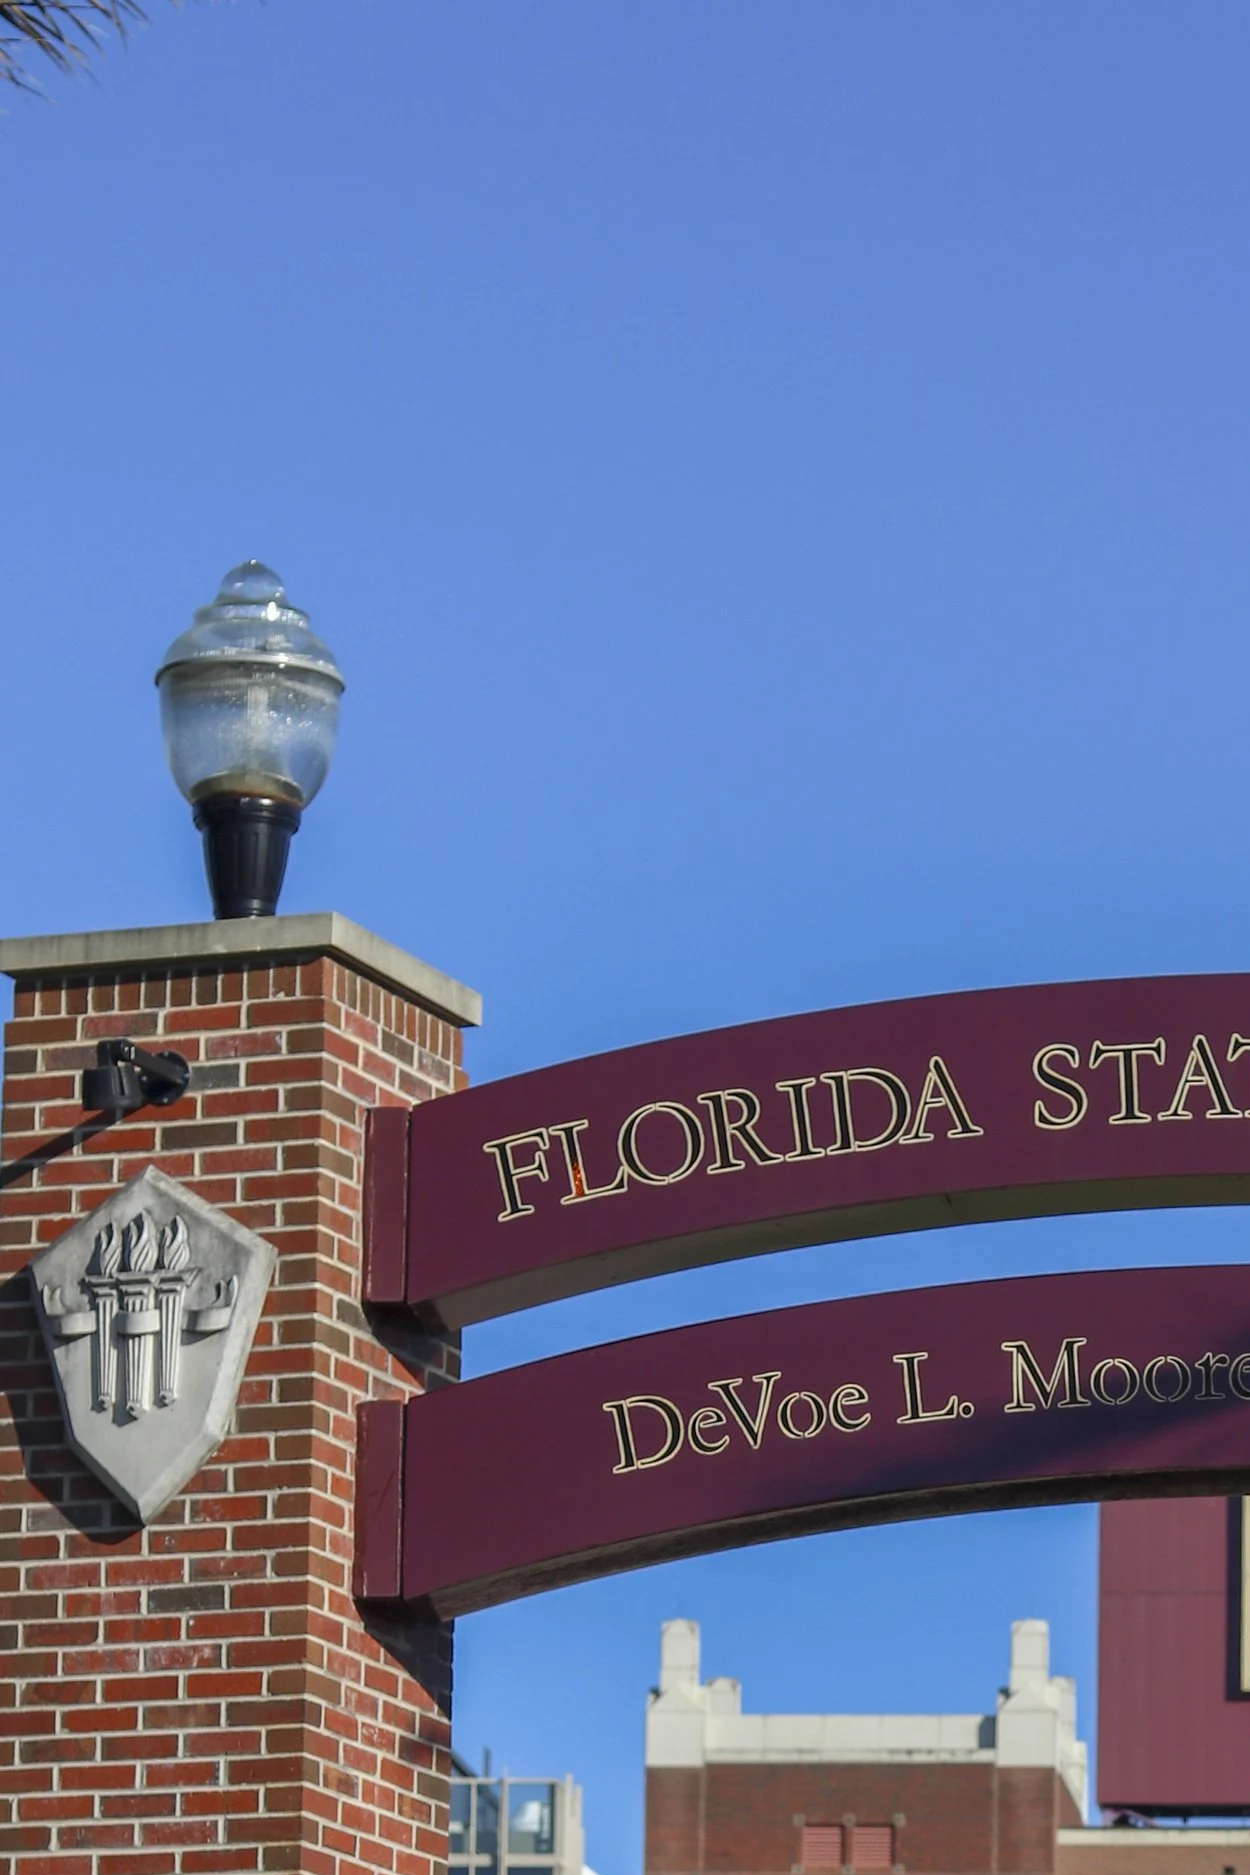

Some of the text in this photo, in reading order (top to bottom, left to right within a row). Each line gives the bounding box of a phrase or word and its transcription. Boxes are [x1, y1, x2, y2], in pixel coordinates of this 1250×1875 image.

[485, 1056, 983, 1222] FLORIDA
[603, 1372, 871, 1474] DeVoe
[893, 1353, 975, 1426] L.
